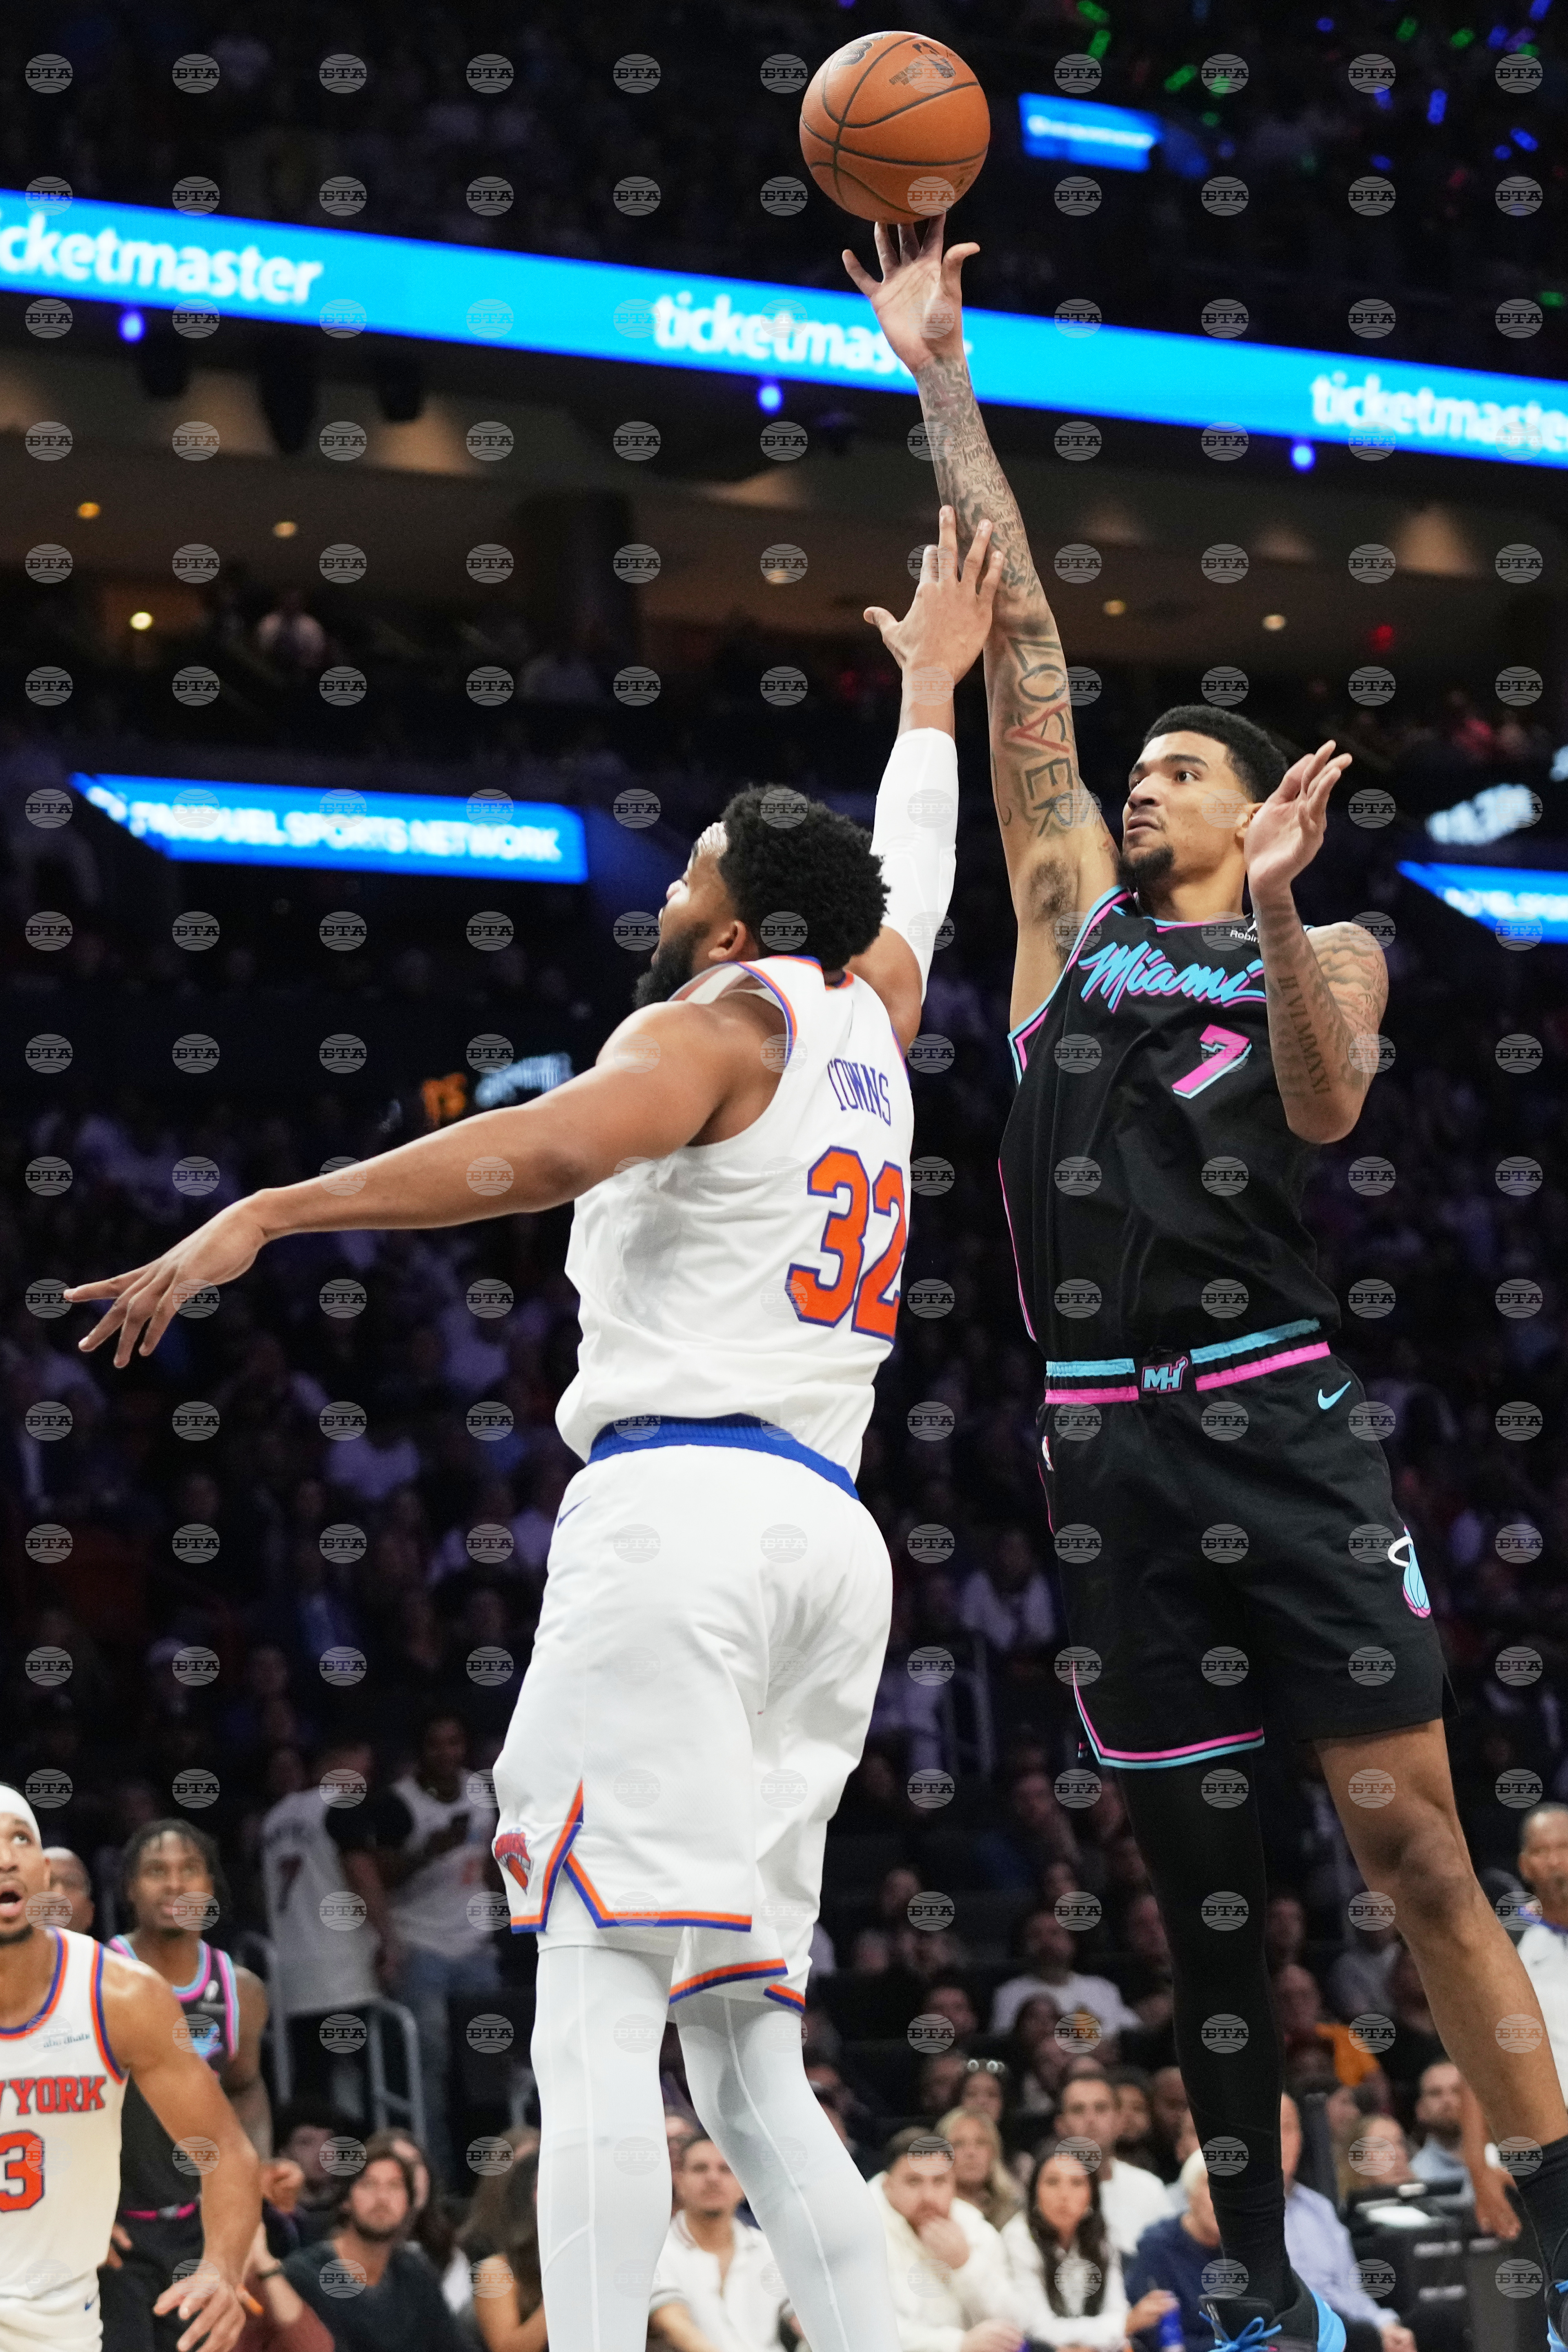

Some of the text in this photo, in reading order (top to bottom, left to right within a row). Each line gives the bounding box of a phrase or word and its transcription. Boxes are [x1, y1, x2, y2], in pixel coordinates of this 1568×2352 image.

[0, 211, 324, 304] cketmaster
[653, 290, 973, 377] ticketmas
[1078, 941, 1267, 1013] Miami
[827, 1058, 891, 1127] TOWNS
[1172, 1023, 1252, 1099] 7
[784, 1145, 907, 1348] 32
[10, 2075, 106, 2116] YORK
[0, 2129, 45, 2212] 3
